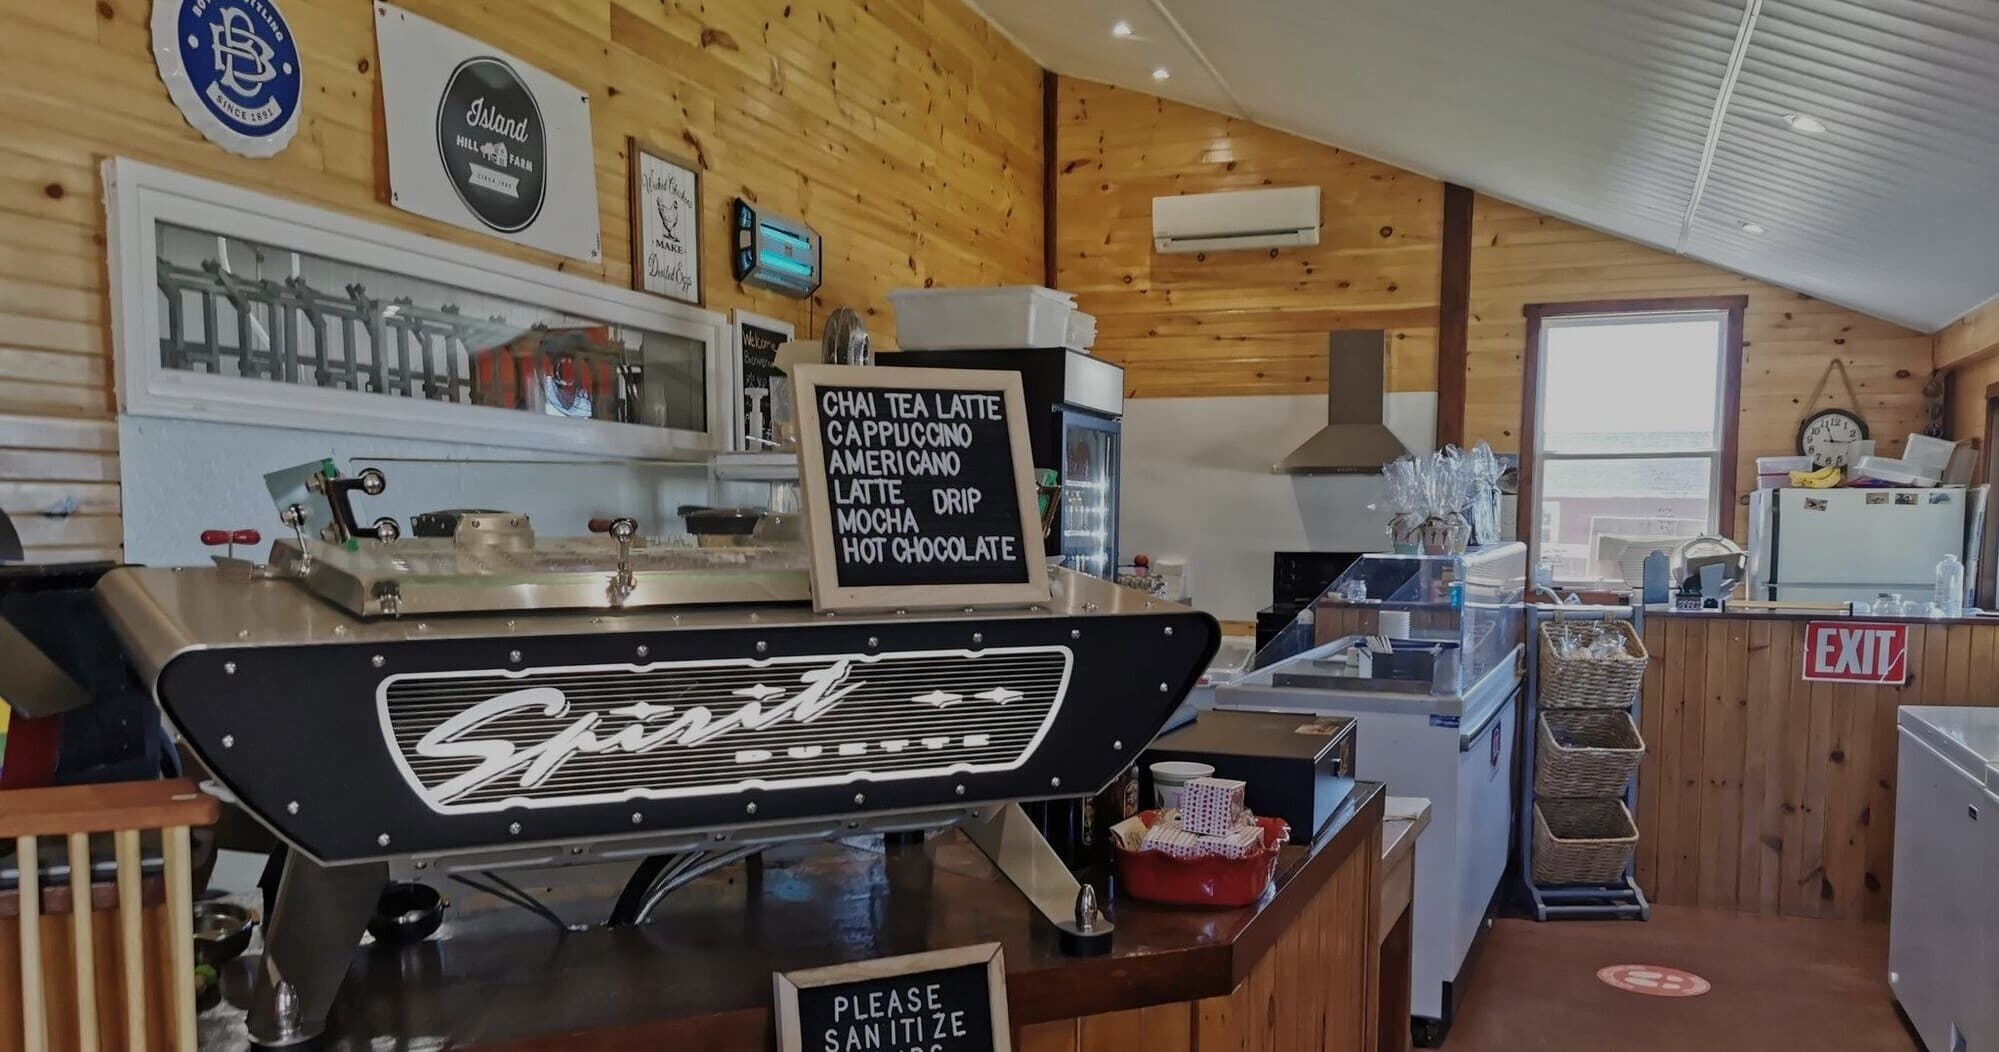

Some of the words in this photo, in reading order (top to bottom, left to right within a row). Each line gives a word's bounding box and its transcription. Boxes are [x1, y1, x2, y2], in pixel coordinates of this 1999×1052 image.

[216, 95, 248, 121] SINCE
[251, 107, 274, 122] 1891
[466, 96, 529, 143] Island
[456, 134, 479, 153] HILL
[509, 153, 533, 173] FARM
[655, 239, 684, 255] MAKE
[823, 391, 875, 418] CHAI
[884, 392, 930, 419] TEA
[936, 393, 1002, 421] LATTE
[827, 421, 973, 448] CAPPUCCINO
[829, 449, 961, 477] AMERICANO
[833, 478, 905, 505] LATTE
[932, 487, 982, 515] DRIP
[837, 507, 920, 534] MOCHA
[843, 537, 887, 564] HOT
[891, 536, 1017, 563] CHOCOLATE
[1815, 628, 1896, 676] EXIT
[416, 656, 867, 805] Spirit
[735, 733, 990, 764] DUETTE
[834, 983, 943, 1024] PLEASE
[824, 1011, 967, 1052] SANITIZE
